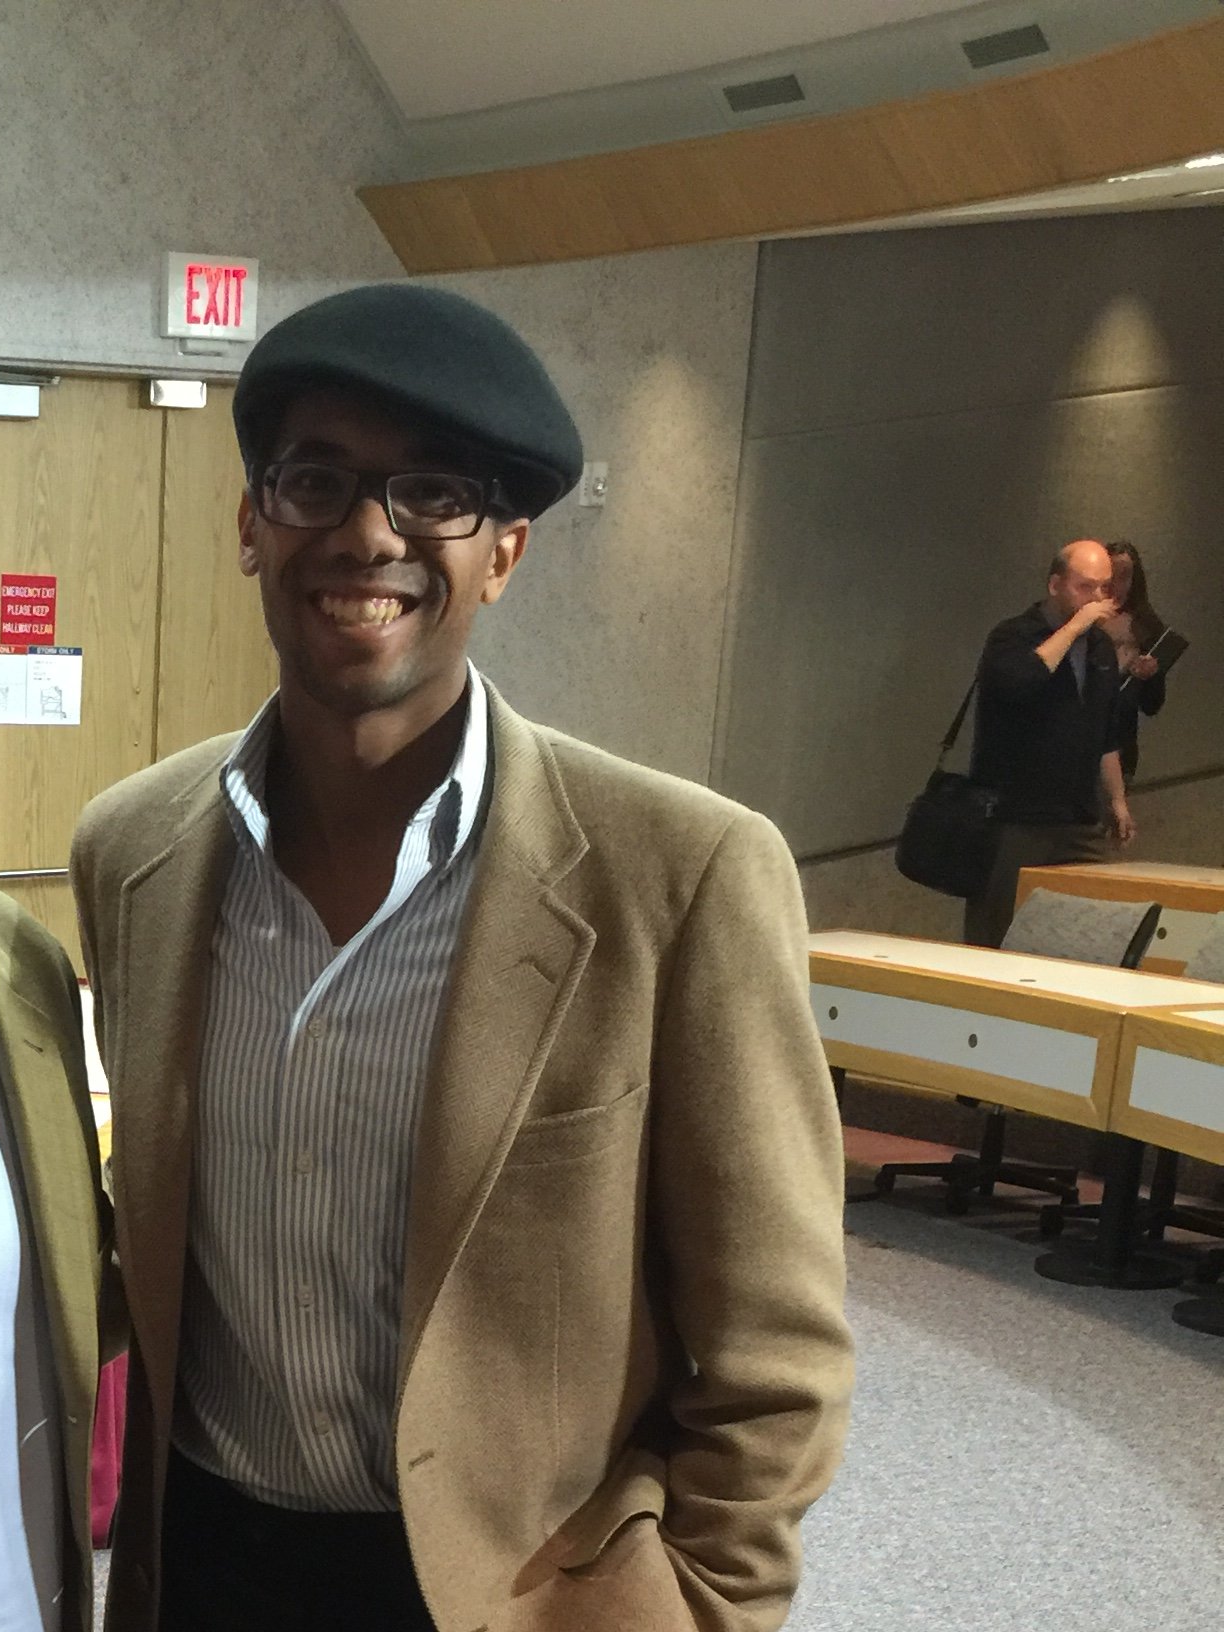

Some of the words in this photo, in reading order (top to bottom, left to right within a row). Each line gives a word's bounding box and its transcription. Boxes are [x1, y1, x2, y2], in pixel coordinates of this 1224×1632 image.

[186, 266, 246, 327] EXIT
[2, 586, 40, 597] EMERGENCY
[7, 604, 31, 615] PLEASE
[33, 605, 49, 616] KEEP
[2, 622, 31, 633] HALLWAY
[32, 624, 53, 634] CLEAR
